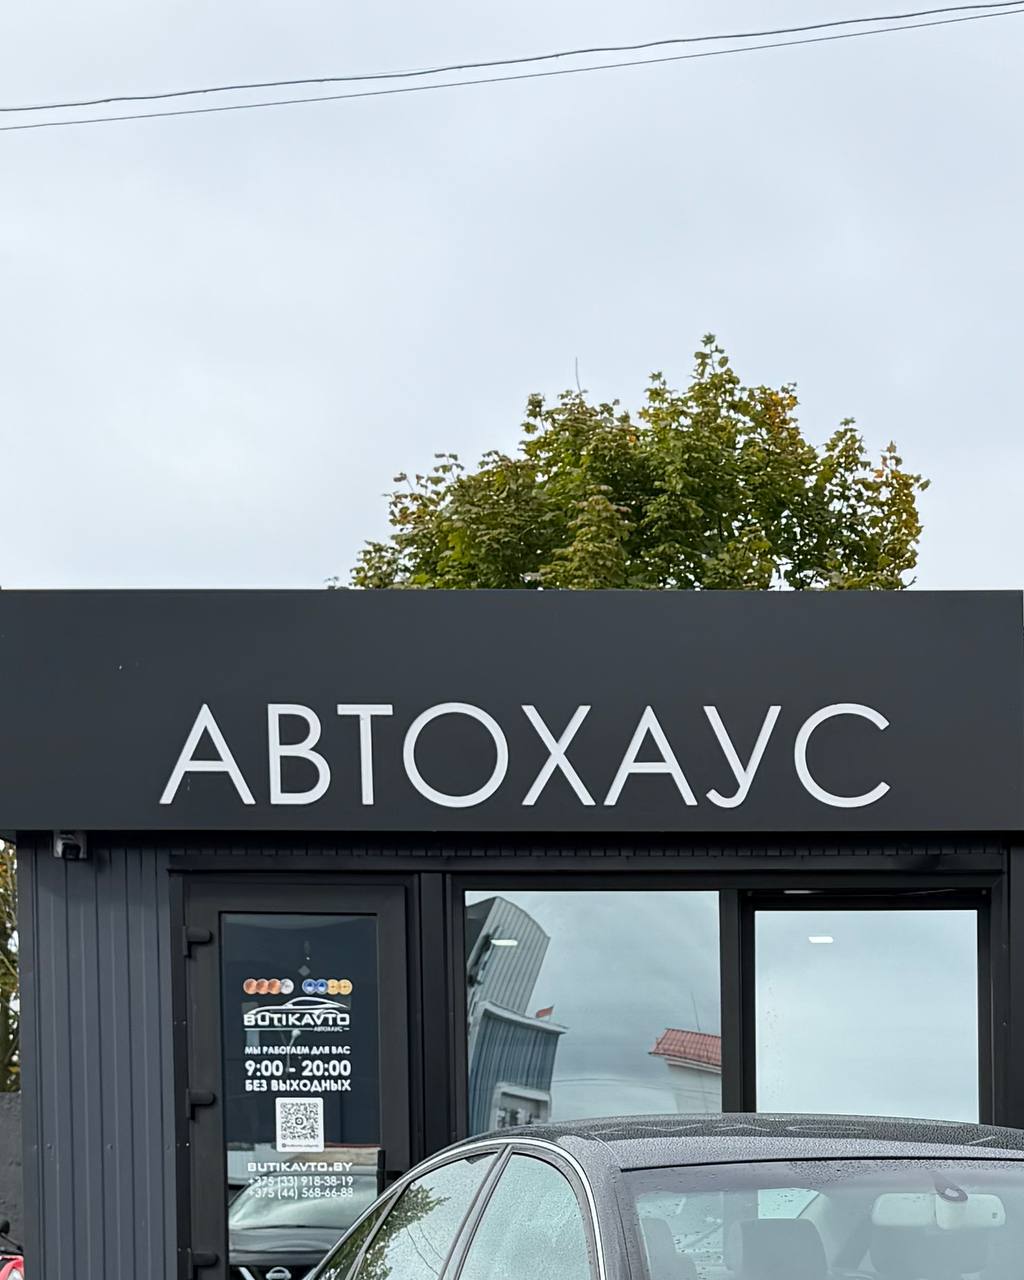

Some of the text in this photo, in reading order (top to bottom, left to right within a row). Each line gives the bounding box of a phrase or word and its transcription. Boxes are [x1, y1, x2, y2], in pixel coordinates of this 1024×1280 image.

[159, 702, 891, 808] АВТОХАУС
[243, 1013, 350, 1026] BUTIKAVTO
[244, 1046, 351, 1055] МЫ РАБОТАЕМ ДЛЯ ВАС
[245, 1060, 284, 1076] 9:00
[301, 1060, 351, 1076] 20:00
[245, 1079, 351, 1093] БЕЗ ВЫХОДНЫХ
[247, 1162, 353, 1172] BUTIKAVTO.BY
[278, 1175, 298, 1188] (33)
[301, 1176, 353, 1187] 918-38-19
[278, 1187, 298, 1200] (44)
[301, 1187, 353, 1198] 568-66-88
